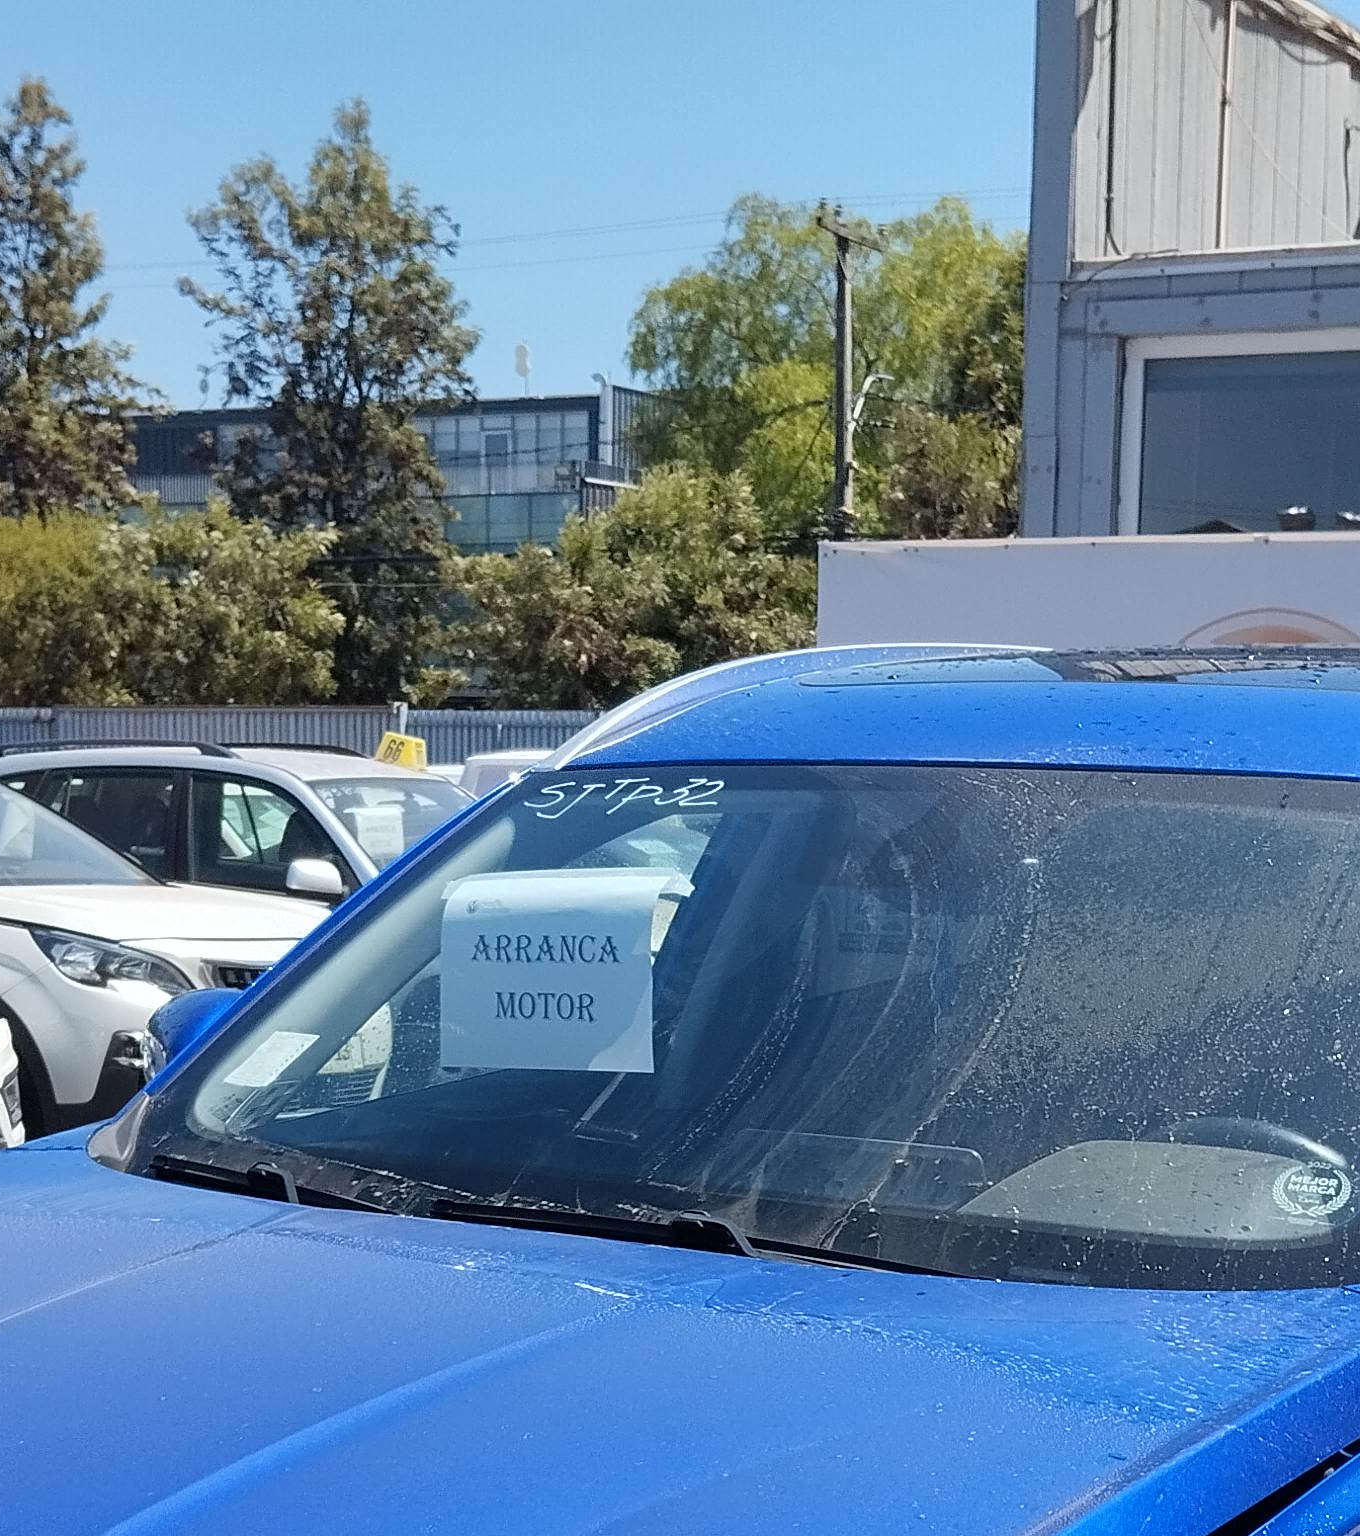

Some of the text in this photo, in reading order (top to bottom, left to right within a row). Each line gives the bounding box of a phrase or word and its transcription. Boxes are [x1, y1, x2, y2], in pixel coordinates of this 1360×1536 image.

[383, 739, 405, 762] 66
[471, 934, 623, 964] ARRANCA
[495, 992, 596, 1023] MOTOR
[1287, 1183, 1336, 1197] MARCA
[1290, 1174, 1339, 1189] MEJOR
